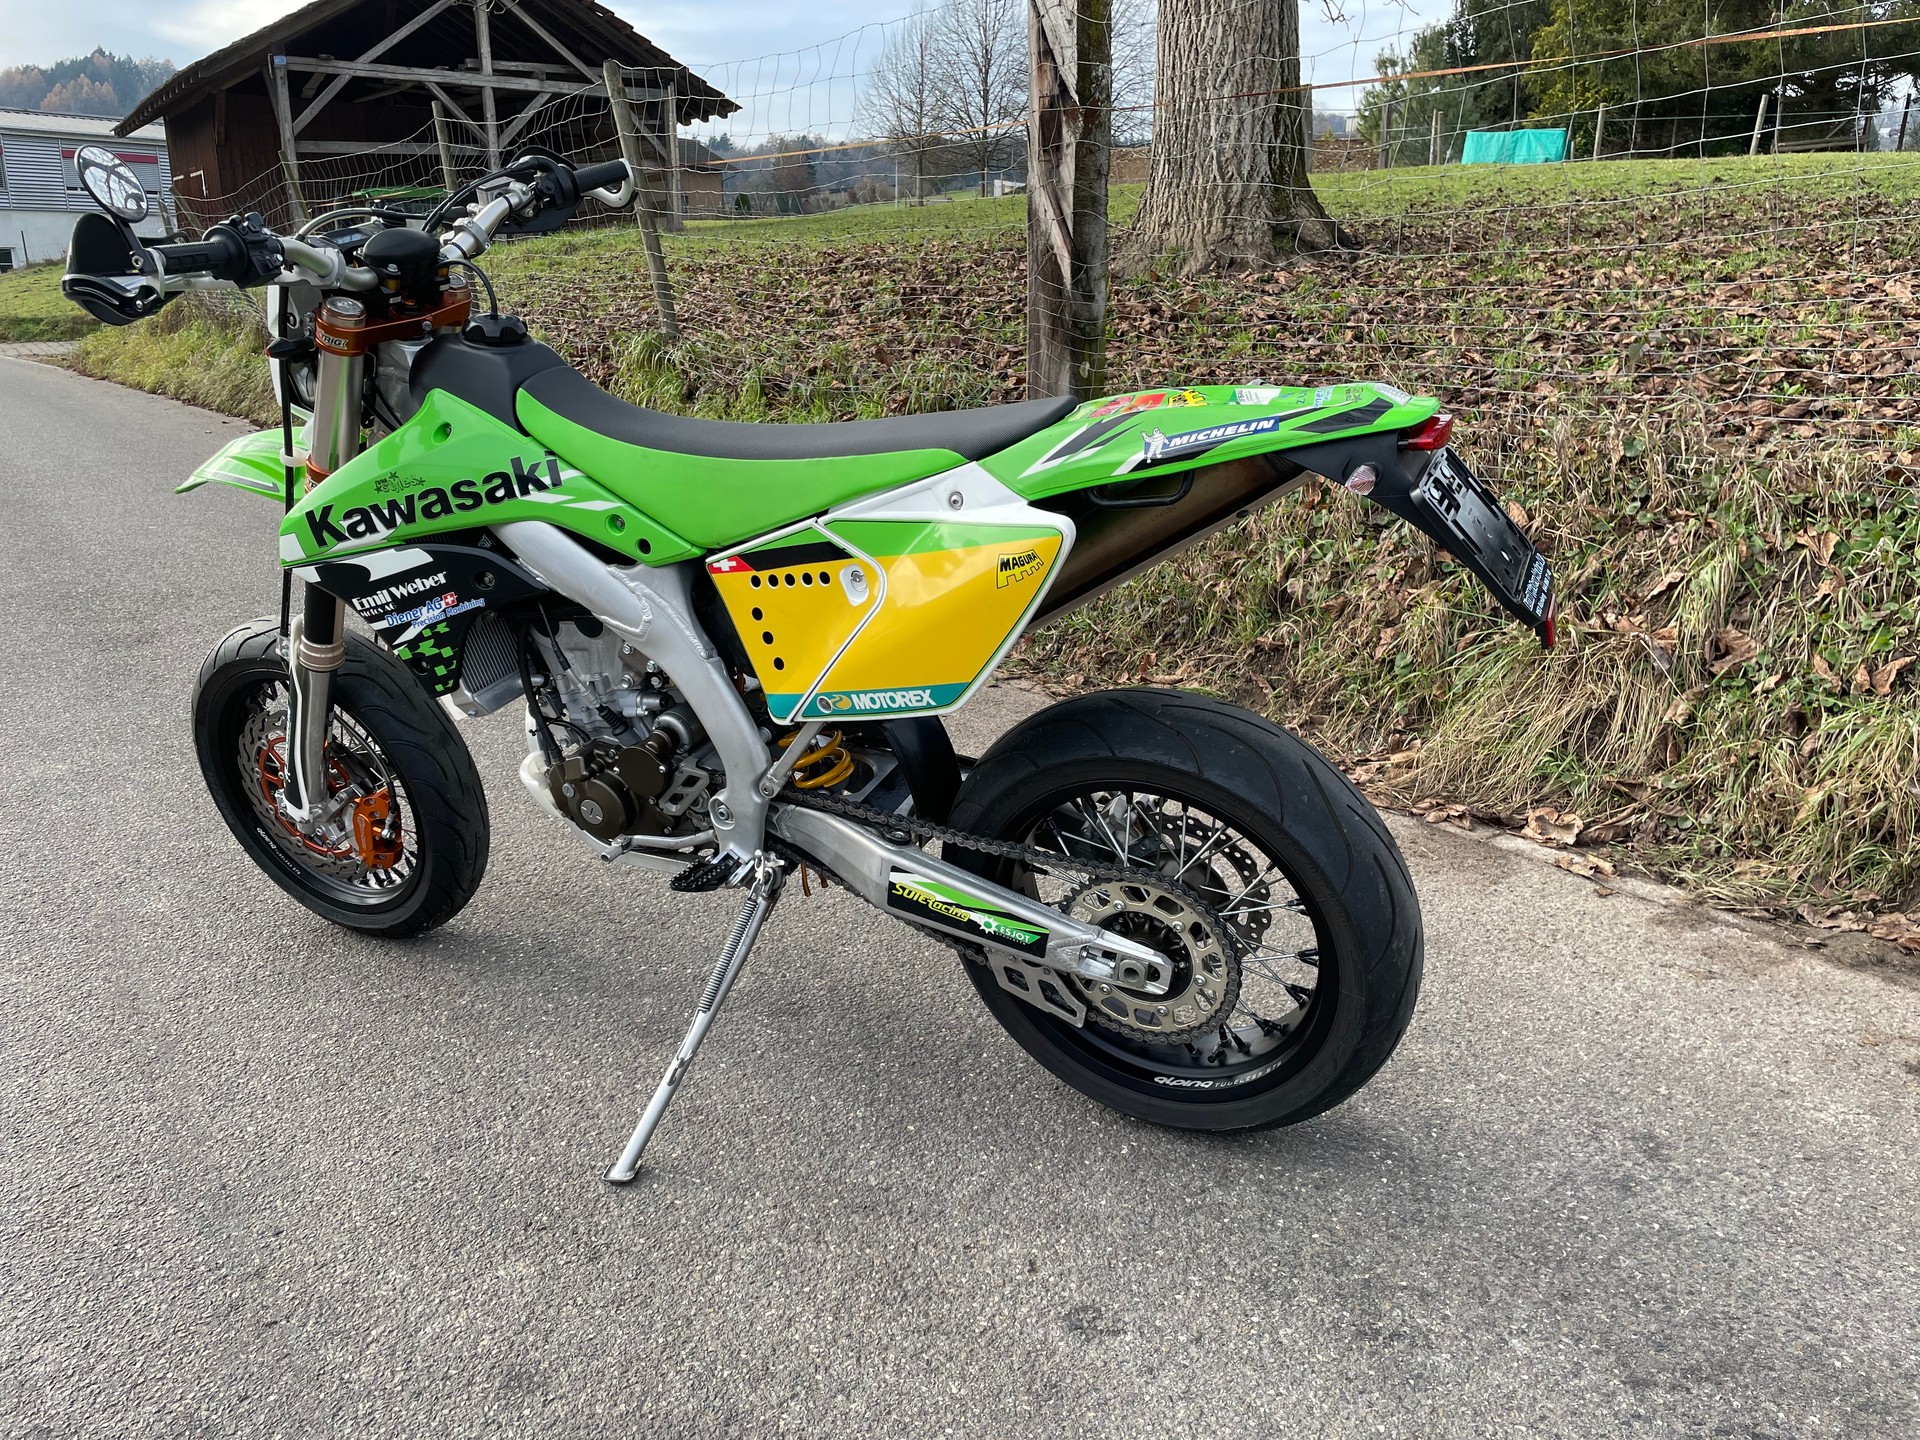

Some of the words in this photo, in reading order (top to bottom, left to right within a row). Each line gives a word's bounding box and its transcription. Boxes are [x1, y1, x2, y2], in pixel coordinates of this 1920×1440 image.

[1169, 419, 1276, 448] MICHELIN
[305, 450, 564, 548] Kawasaki
[1000, 551, 1038, 572] MAGURA
[351, 589, 393, 611] Emil
[388, 571, 447, 600] Weber
[384, 605, 425, 627] Diener
[425, 596, 443, 614] AG
[411, 611, 446, 629] Precision
[445, 597, 486, 617] Machining
[850, 689, 937, 711] MOTOREX
[1000, 926, 1030, 943] ESJOT
[1153, 1076, 1214, 1089] alpina
